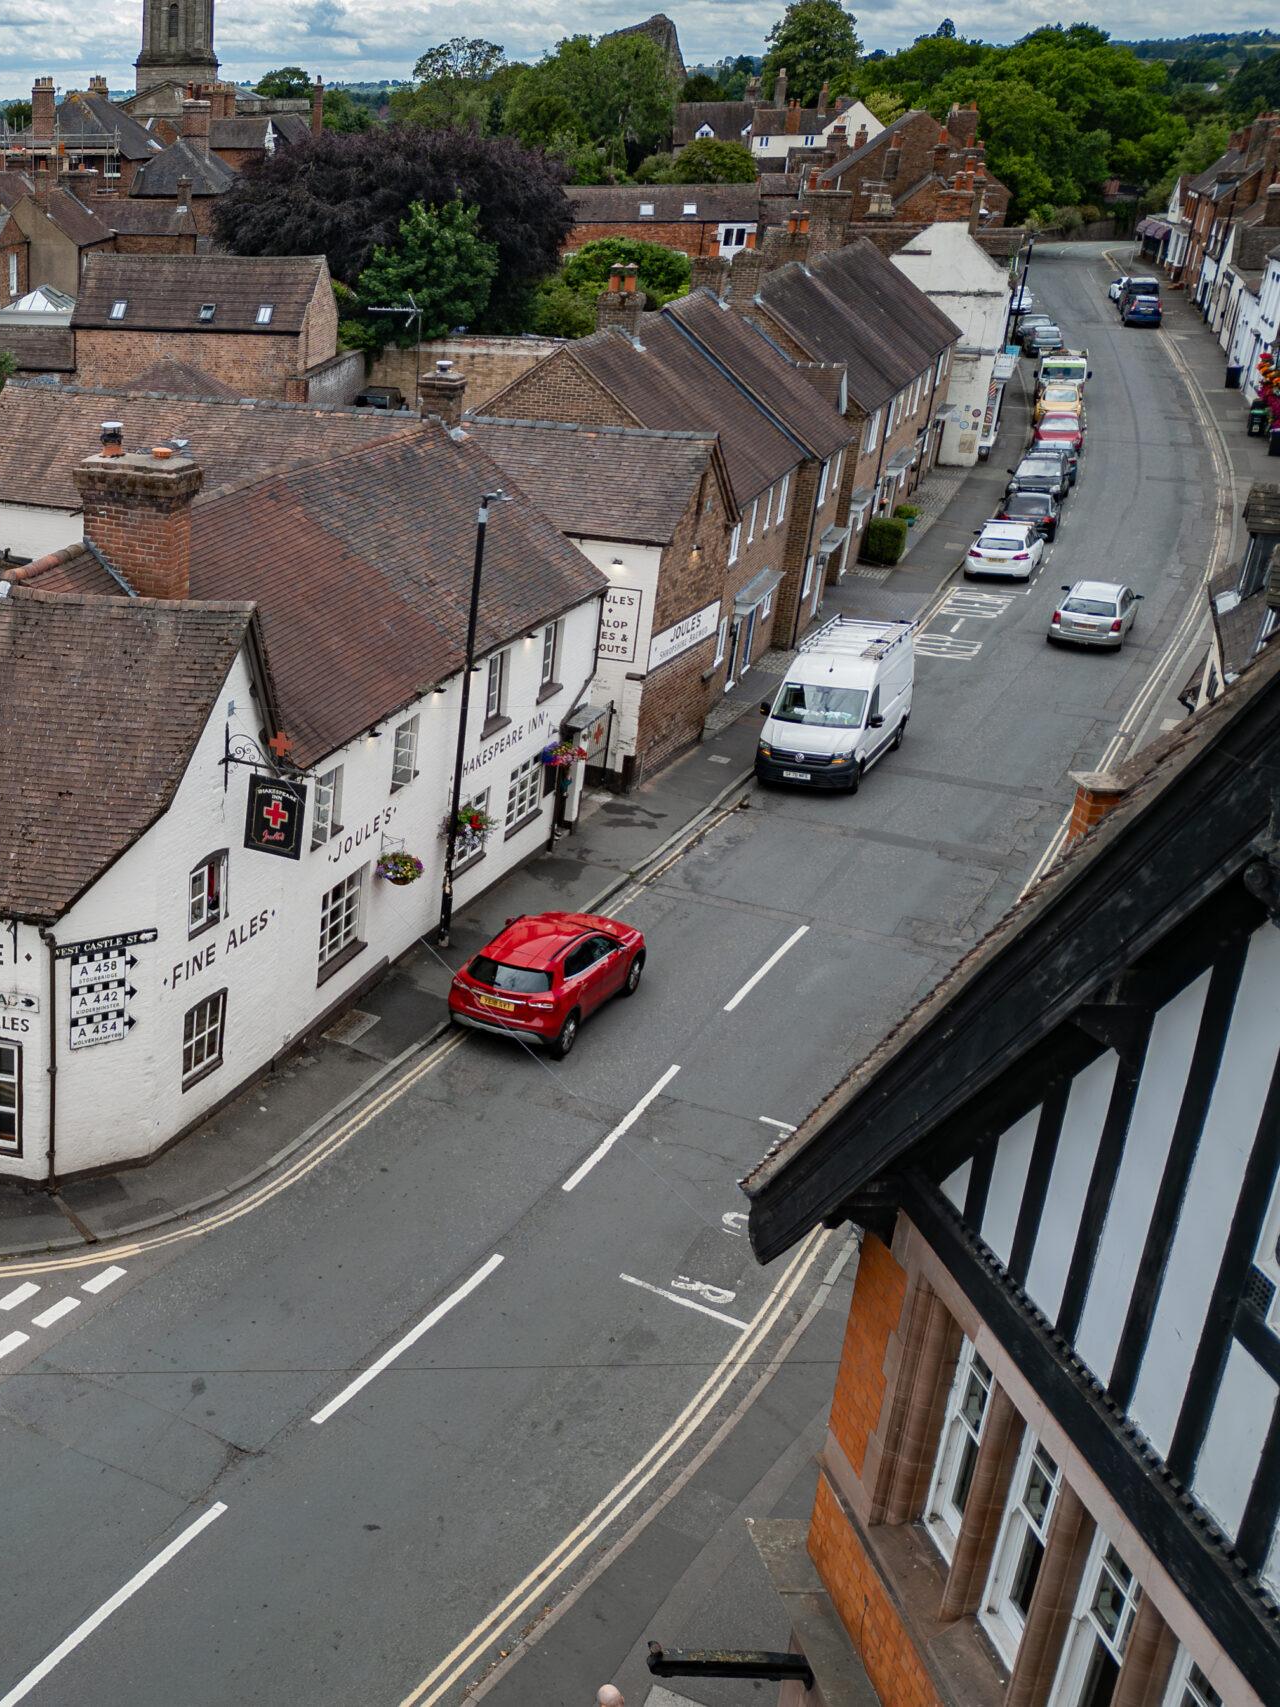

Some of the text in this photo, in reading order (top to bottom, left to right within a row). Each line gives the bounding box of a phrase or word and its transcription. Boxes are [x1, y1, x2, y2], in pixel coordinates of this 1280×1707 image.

[604, 595, 635, 606] ULE'S
[601, 631, 629, 642] ES &
[599, 643, 628, 654] OUTS
[462, 711, 545, 778] HAKESPEARE INN
[257, 788, 298, 802] SHAKESPEARE
[332, 807, 392, 863] JOULE'S
[84, 937, 123, 952] CASTLE
[171, 909, 269, 990] FINE ALES
[80, 960, 118, 977] A 458
[79, 972, 118, 985] STOURBRIDGE
[79, 991, 118, 1008] A 442
[76, 1002, 121, 1015] KIDDERMINSTER
[78, 1021, 117, 1038] A 454
[73, 1032, 122, 1046] WOLVERHAMPTON
